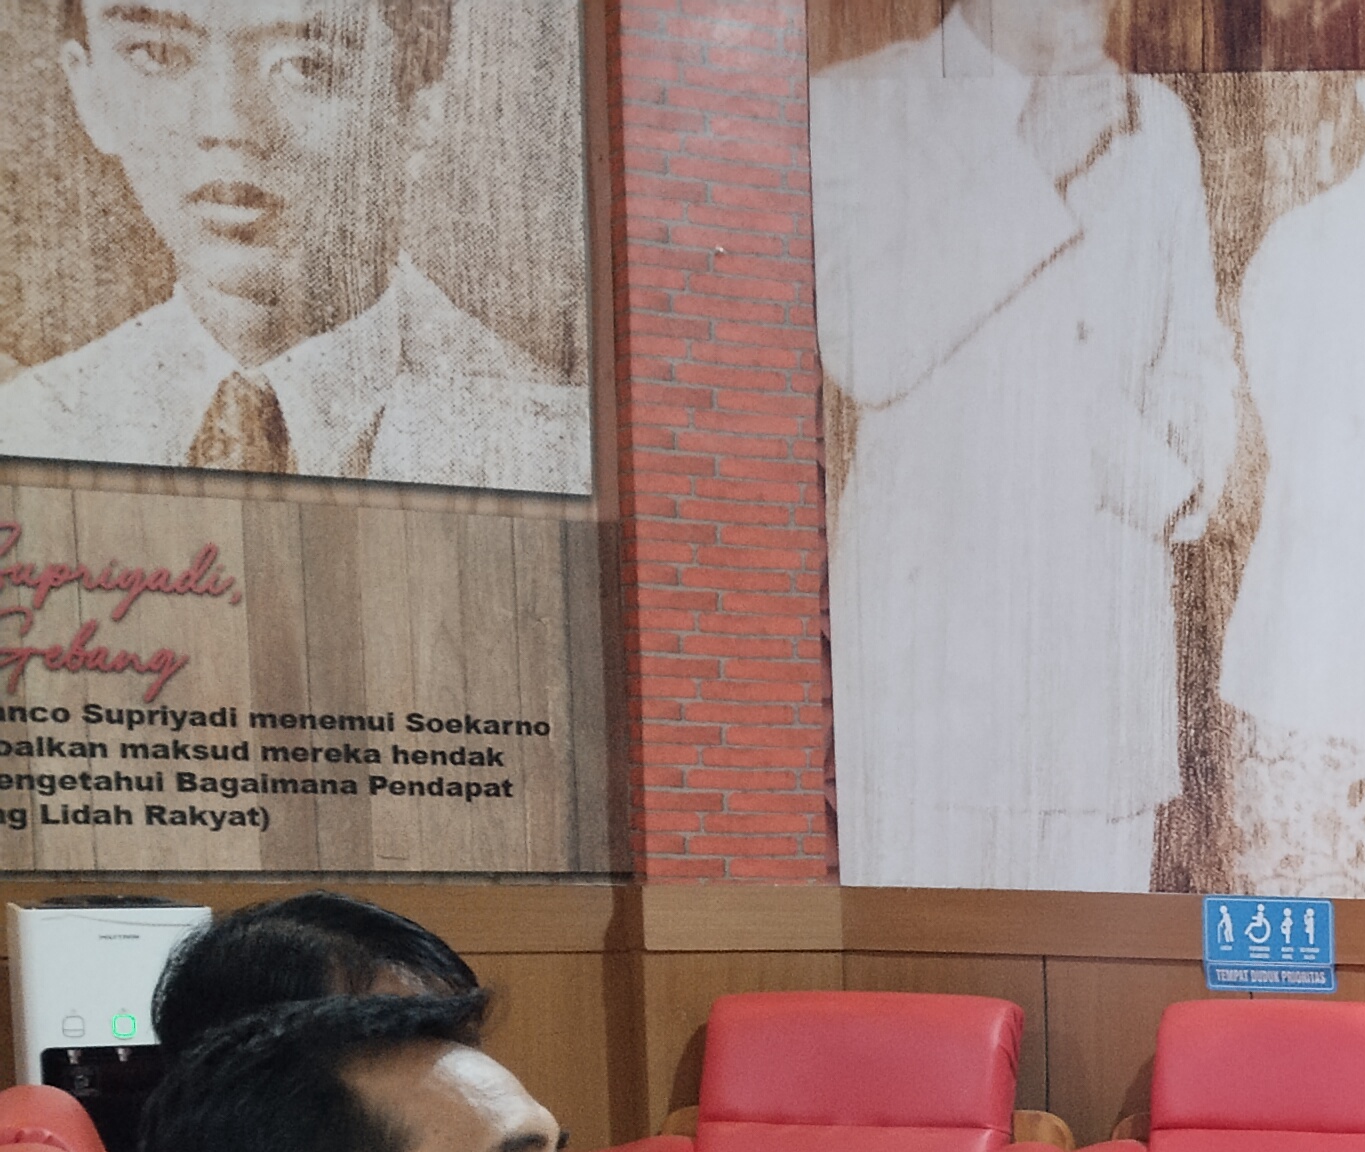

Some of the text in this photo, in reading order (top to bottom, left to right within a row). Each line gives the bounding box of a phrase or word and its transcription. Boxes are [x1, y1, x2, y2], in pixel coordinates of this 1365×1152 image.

[82, 703, 237, 731] Supriyadi
[249, 709, 395, 733] menemui
[405, 712, 551, 737] Soekarno
[120, 738, 249, 762] maksud
[261, 740, 382, 765] mereka
[392, 743, 504, 768] hendak
[176, 772, 356, 798] Bagaimana
[368, 775, 514, 803] Pendapat
[40, 804, 133, 826] Lidah
[145, 804, 270, 832] Rakyat)
